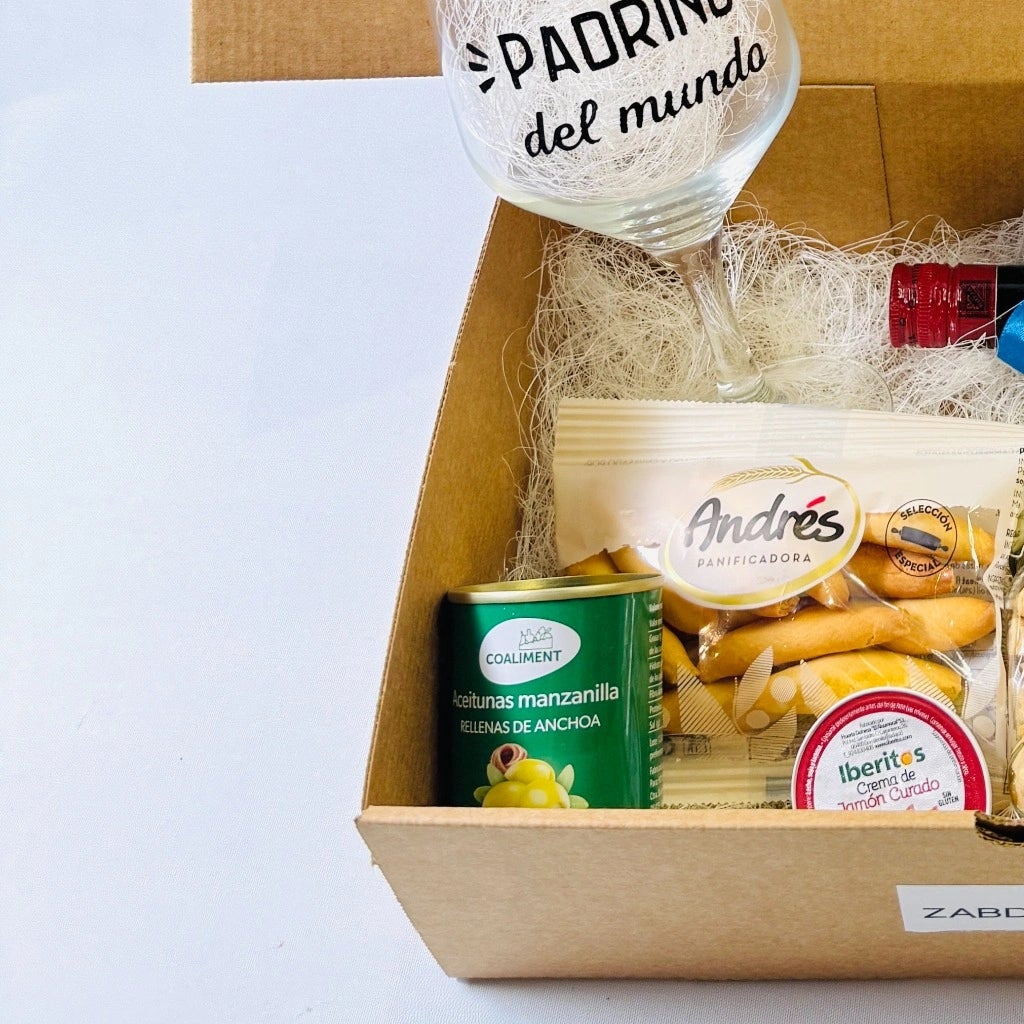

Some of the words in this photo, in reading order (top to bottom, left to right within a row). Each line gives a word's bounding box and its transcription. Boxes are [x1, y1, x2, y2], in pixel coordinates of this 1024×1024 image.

[524, 99, 601, 158] del
[619, 36, 768, 134] mundo
[684, 494, 845, 551] Andrés
[900, 505, 953, 532] SELECCIÓN
[697, 552, 811, 568] PANIFICADORA
[894, 551, 942, 572] ESPECIAL
[486, 650, 562, 665] COALIMENT
[452, 689, 514, 709] Aceitunas
[518, 682, 619, 709] manzanilla
[460, 720, 510, 734] RELLENAS
[513, 720, 531, 733] DE
[534, 715, 601, 733] ANCHOA
[838, 747, 925, 783] Iberitos
[838, 792, 888, 811] Jamón
[889, 777, 940, 801] Curado
[857, 775, 898, 795] Crema
[901, 769, 916, 782] de
[938, 796, 959, 806] GLUTEN
